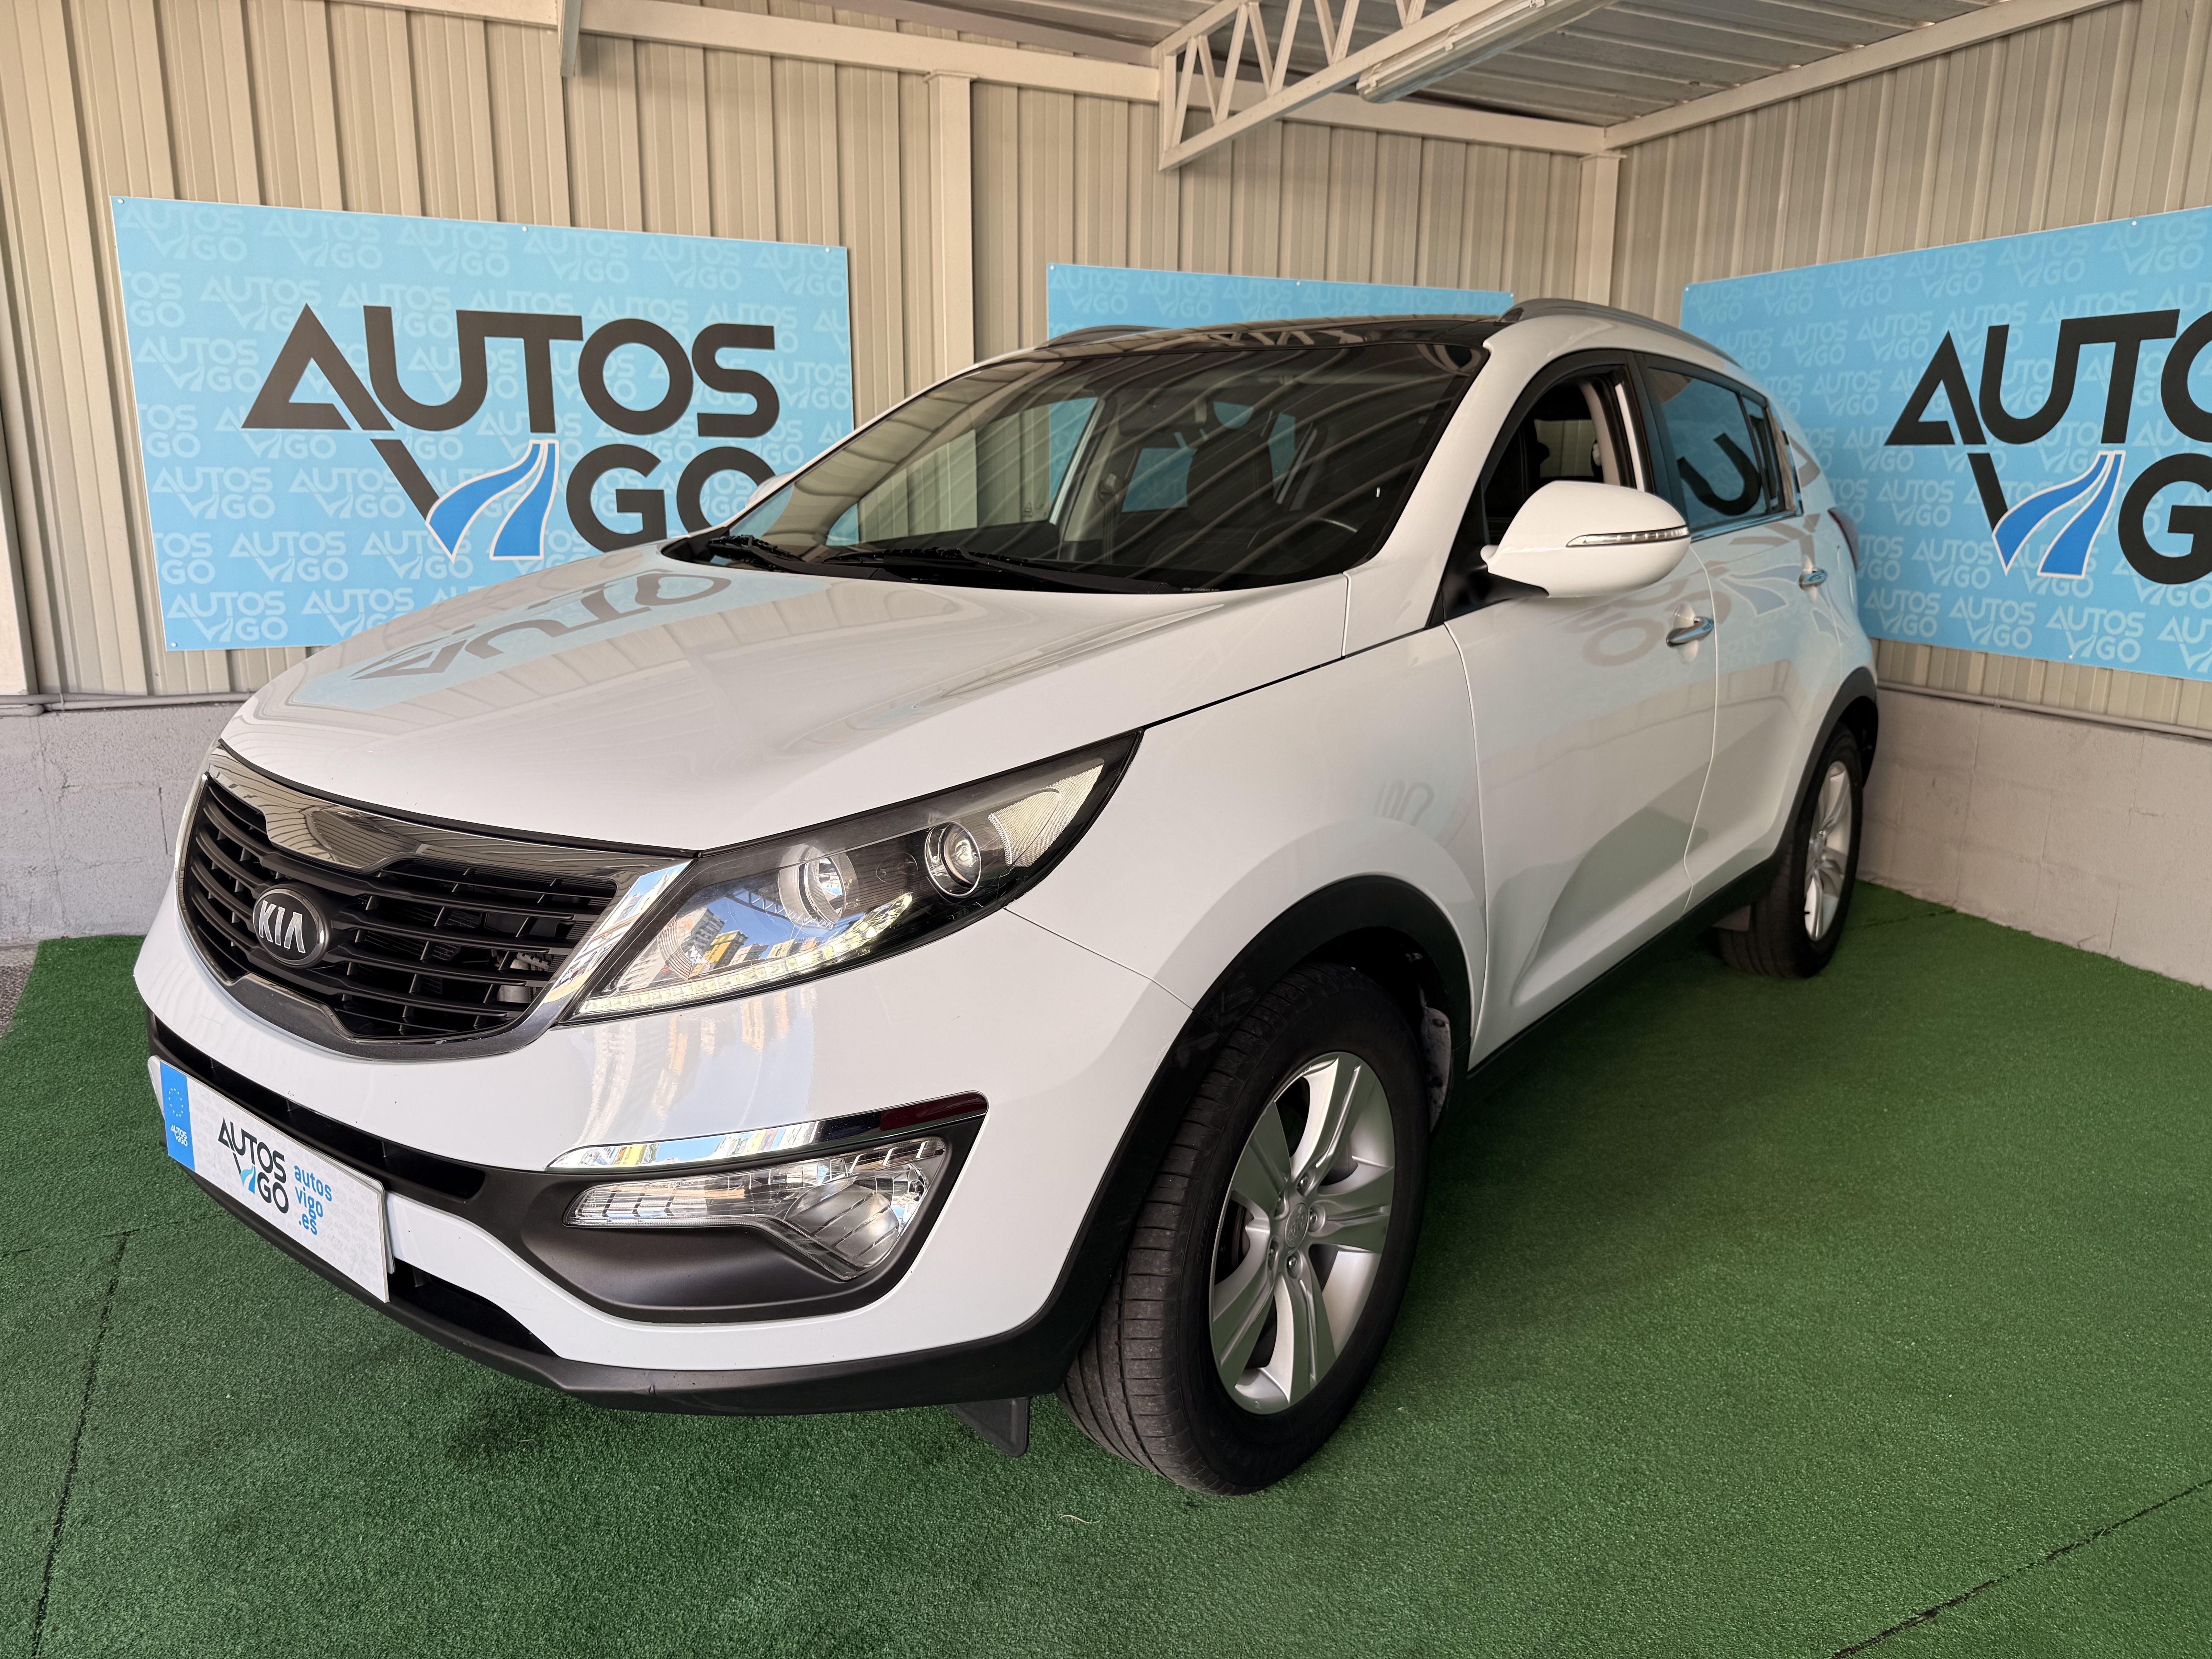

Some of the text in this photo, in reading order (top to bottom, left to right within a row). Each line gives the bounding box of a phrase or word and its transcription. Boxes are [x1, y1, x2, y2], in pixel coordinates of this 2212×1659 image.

[119, 204, 246, 234] AUTOS
[262, 212, 381, 243] AUTOS
[2100, 211, 2211, 252] AUTOS
[147, 231, 247, 262] VIGO
[396, 220, 508, 251] AUTOS
[522, 230, 628, 259] AUTOS
[1996, 229, 2091, 266] AUTOS
[289, 239, 383, 270] VIGO
[422, 248, 510, 277] VIGO
[642, 238, 741, 266] AUTOS
[754, 246, 844, 273] AUTOS
[1904, 244, 1989, 278] AUTOS
[547, 256, 630, 284] VIGO
[665, 262, 742, 291] VIGO
[775, 269, 844, 297] VIGO
[1050, 268, 1128, 293] AUTOS
[1752, 268, 1817, 297] AUTOS
[1824, 257, 1896, 288] AUTOS
[199, 275, 322, 307] AUTOS
[1139, 274, 1214, 298] AUTOS
[1222, 280, 1292, 303] AUTOS
[1301, 284, 1369, 306] AUTOS
[1378, 289, 1443, 309] AUTOS
[1687, 280, 1745, 307] AUTOS
[227, 303, 310, 331] VIG
[1857, 311, 1934, 340] AUTOS
[1941, 300, 2029, 332] AUTOS
[1780, 319, 1849, 347] AUTOS
[136, 336, 259, 366] AUTOS
[1793, 343, 1845, 368] VIGO
[1870, 336, 1929, 362] VIGO
[163, 363, 262, 392] VIGO
[241, 302, 780, 438] AUTOS
[1810, 369, 1882, 395] AUTOS
[1824, 392, 1879, 416] VIGO
[151, 466, 272, 493] AUTOS
[289, 467, 403, 493] AUTOS
[1876, 479, 1955, 502] AUTOS
[178, 493, 275, 519] VIGO
[314, 493, 406, 519] VIGO
[1891, 502, 1951, 527] VIGO
[229, 531, 346, 557] AUTOS
[1912, 538, 1994, 565] AUTOS
[255, 557, 348, 582] VIGO
[387, 555, 474, 579] VIGO
[1927, 561, 1991, 589] VIGO
[167, 591, 286, 618] AUTOS
[301, 587, 414, 615] AUTOS
[1864, 587, 1941, 615] AUTOS
[1949, 596, 2037, 626] AUTOS
[193, 616, 288, 642] VIGO
[1878, 612, 1937, 638] VIGO
[1965, 618, 2033, 649] VIGO
[2046, 605, 2146, 638] AUTOS
[2065, 628, 2141, 663] VIGO
[259, 900, 306, 953] KIA
[171, 1124, 187, 1140] AUTOS
[217, 1117, 286, 1183] AUTOS
[232, 1152, 289, 1214] VIGO
[294, 1165, 332, 1202] autos
[295, 1186, 323, 1220] vigo
[299, 1213, 317, 1235] .es
